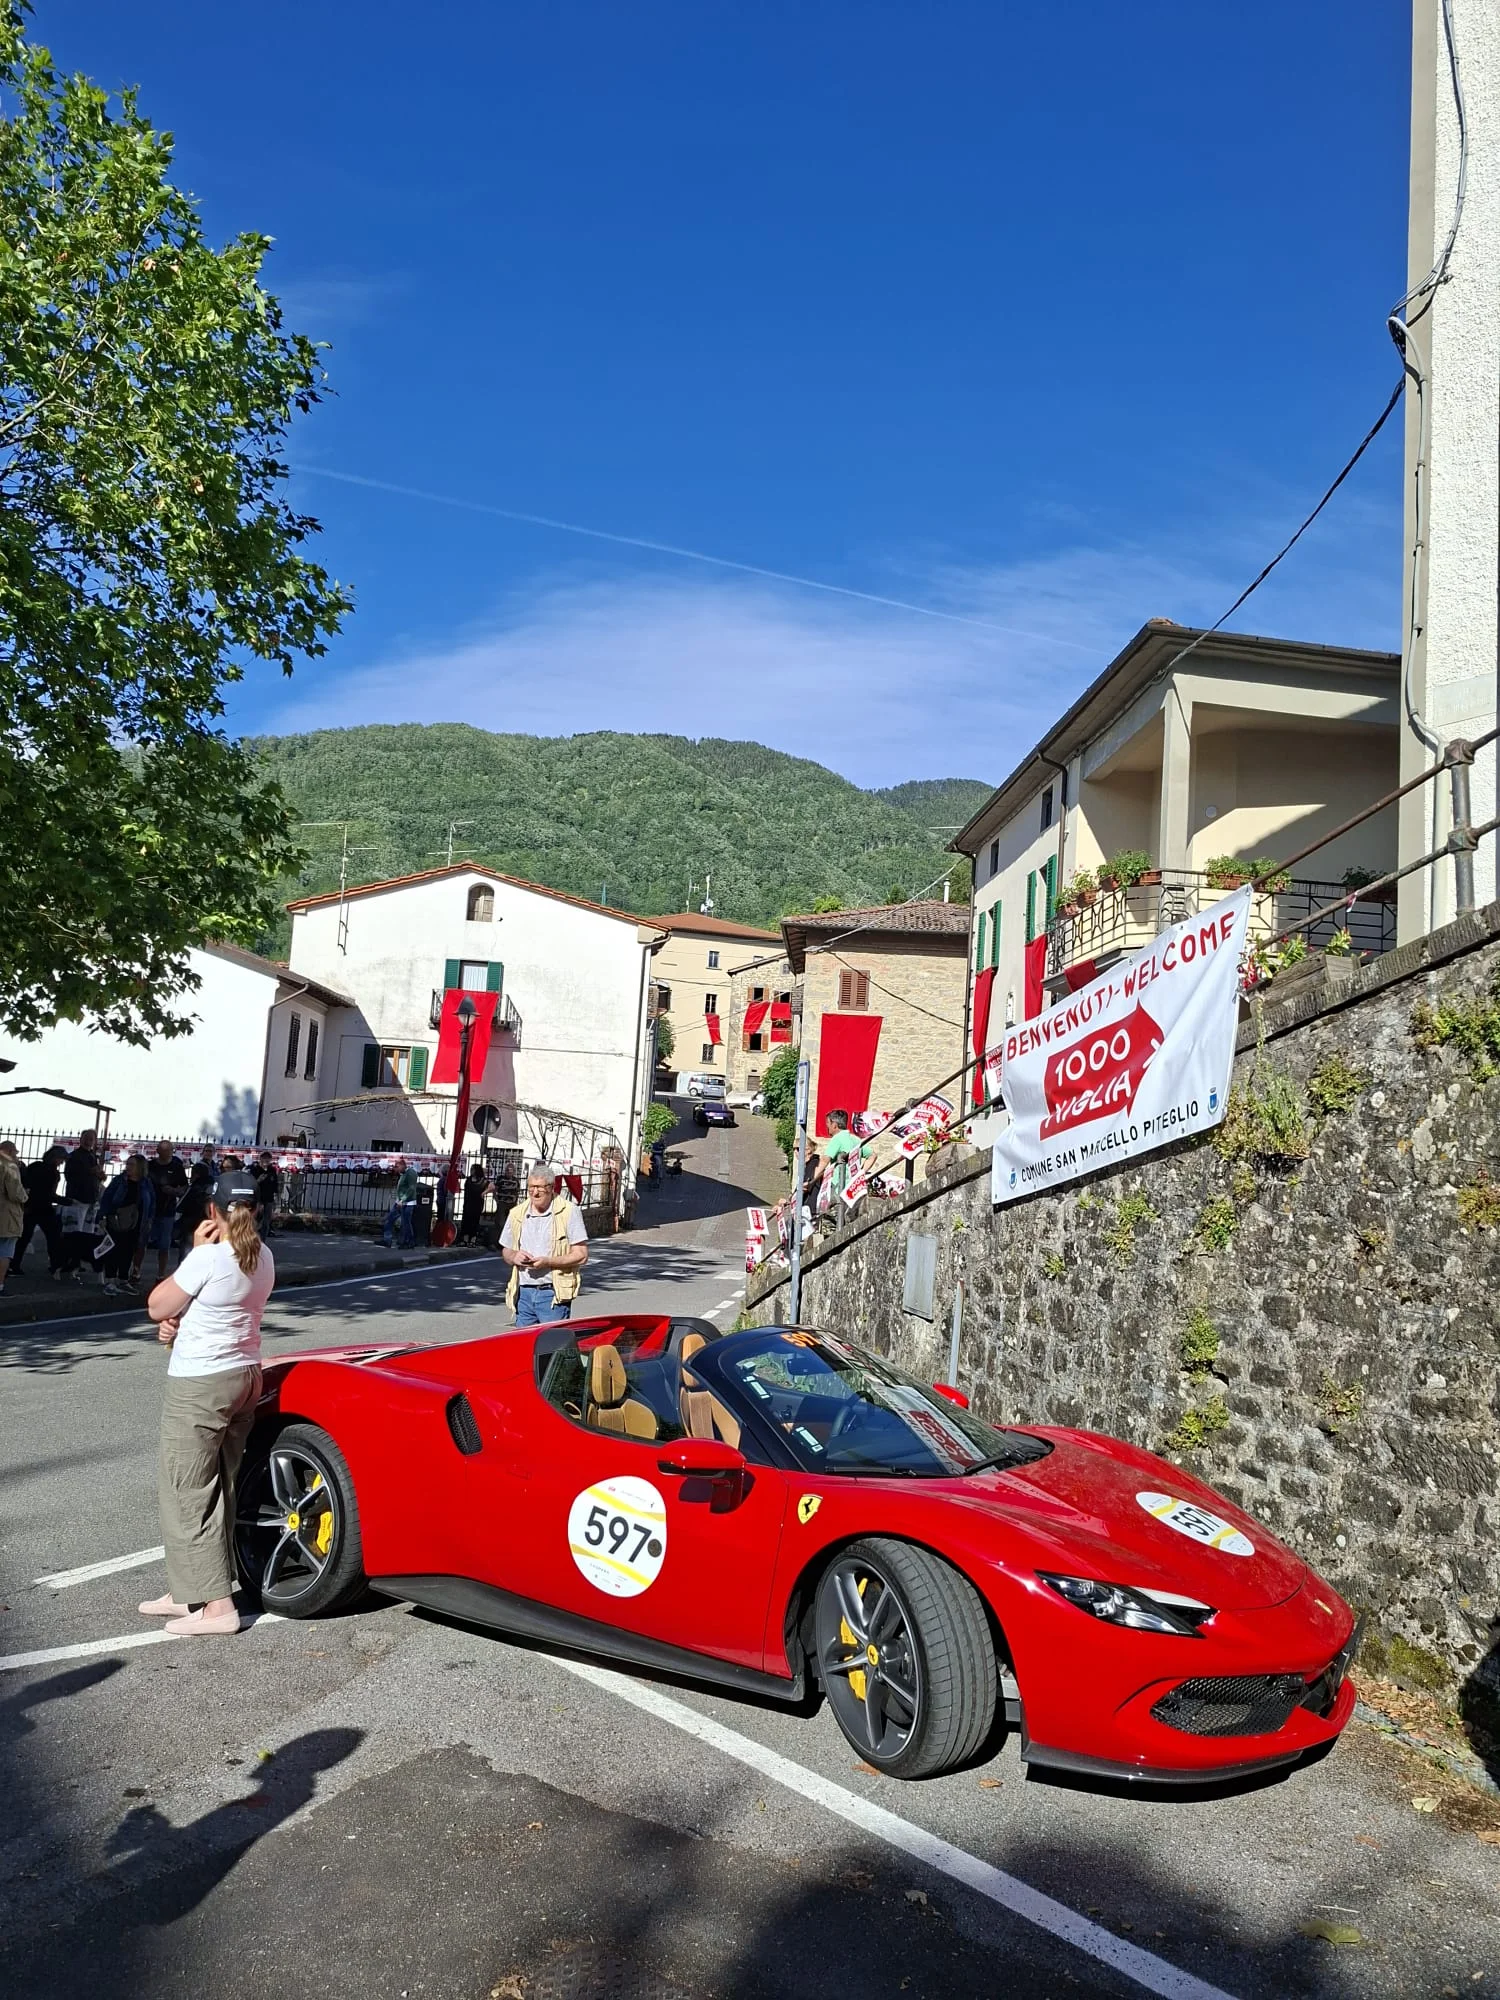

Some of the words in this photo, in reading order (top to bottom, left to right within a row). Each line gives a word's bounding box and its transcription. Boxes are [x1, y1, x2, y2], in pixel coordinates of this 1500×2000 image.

[1055, 1028, 1131, 1087] 1000
[1021, 1157, 1053, 1182] COMUNE
[1055, 1149, 1077, 1169] SAN
[1081, 1125, 1138, 1158] MARCELLO
[1143, 1100, 1199, 1137] PITEGLIO
[781, 1331, 820, 1347] 597
[584, 1505, 652, 1563] 597
[1171, 1507, 1220, 1536] 597
